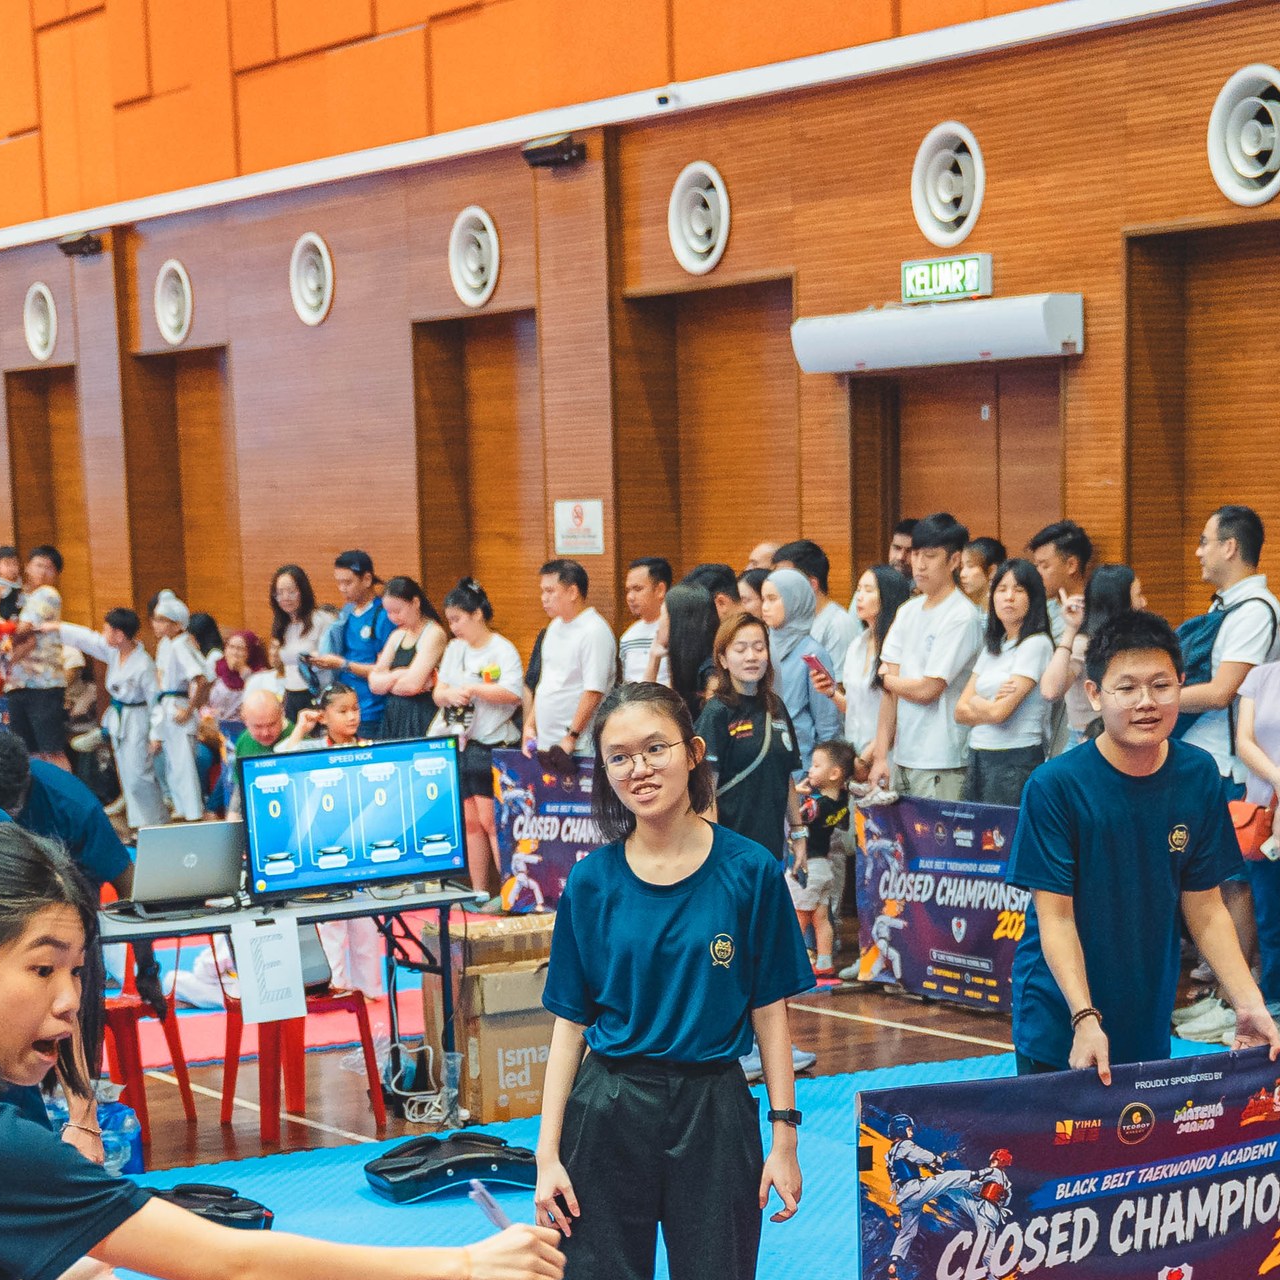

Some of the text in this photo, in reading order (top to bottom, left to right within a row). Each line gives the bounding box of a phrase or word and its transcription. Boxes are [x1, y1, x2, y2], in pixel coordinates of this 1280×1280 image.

[905, 261, 966, 298] KELUAR
[429, 741, 446, 750] MALE
[328, 753, 373, 764] SPEED KICK
[375, 788, 387, 806] 0
[426, 782, 439, 800] 0
[269, 800, 281, 818] 0
[322, 794, 334, 812] 0
[513, 815, 560, 840] CLOSED
[879, 870, 935, 902] CLOSED
[1135, 1071, 1223, 1090] PROUDLY SPONSORED BY
[1075, 1119, 1102, 1135] YIHAI
[1055, 1141, 1278, 1200] BLACK BELT TAEKWONDO ACADEMY
